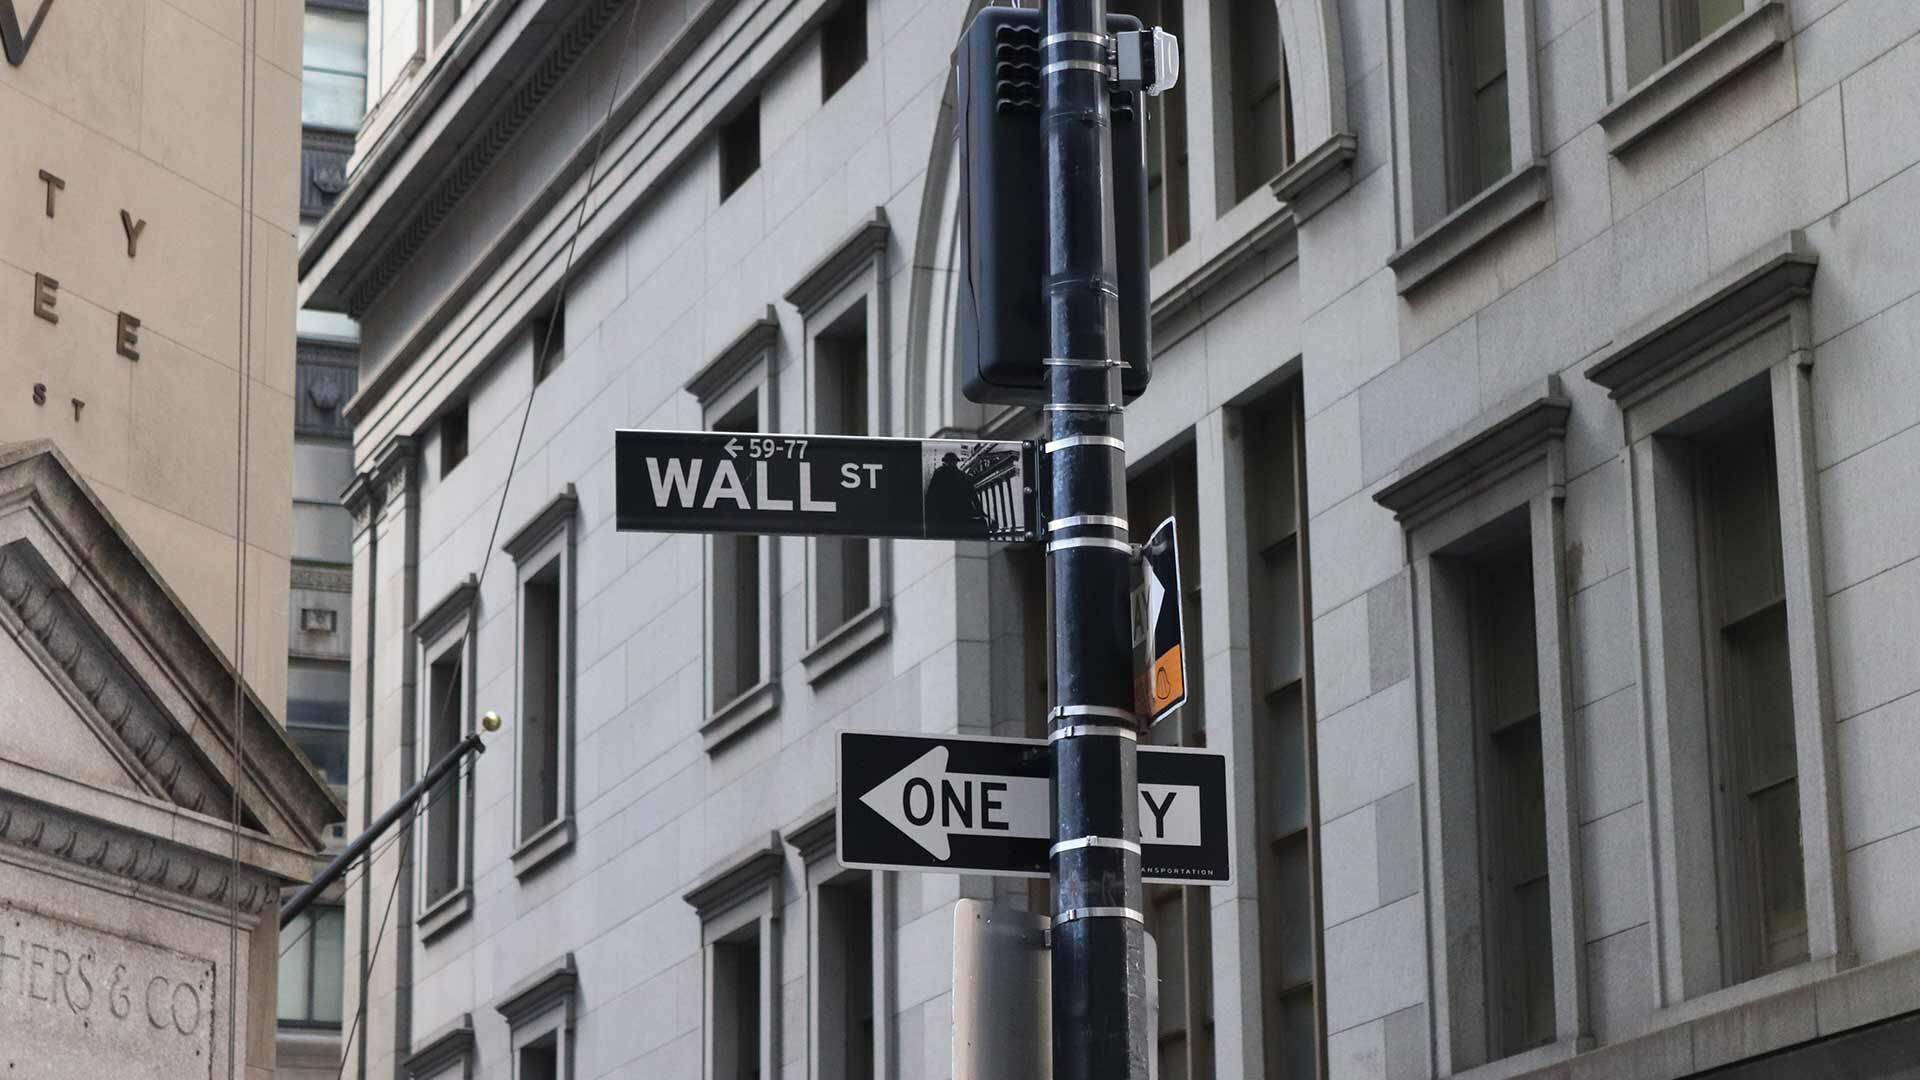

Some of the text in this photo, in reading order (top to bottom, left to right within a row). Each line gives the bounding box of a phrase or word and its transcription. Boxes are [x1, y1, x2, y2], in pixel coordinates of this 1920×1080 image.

[749, 438, 809, 460] 59-77
[645, 457, 883, 513] WALL ST
[902, 777, 1177, 839] ONE Y
[109, 964, 130, 1018] &
